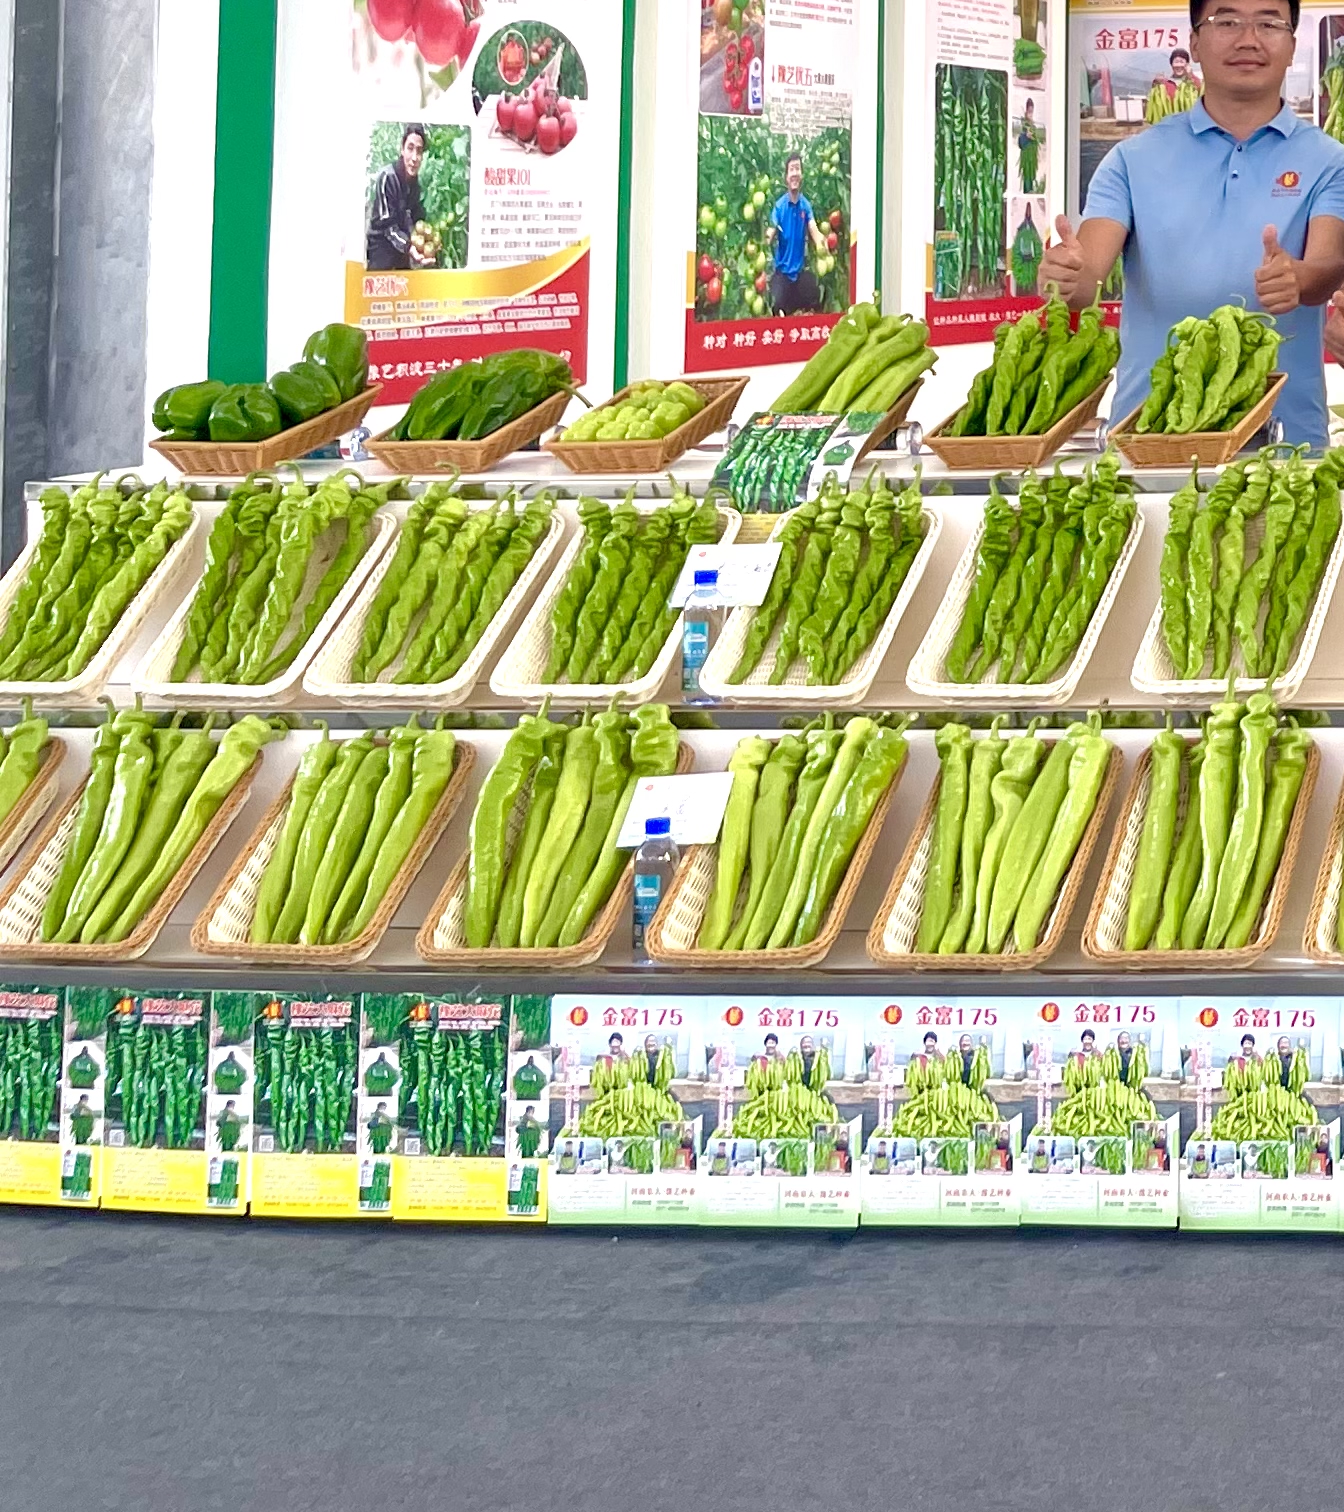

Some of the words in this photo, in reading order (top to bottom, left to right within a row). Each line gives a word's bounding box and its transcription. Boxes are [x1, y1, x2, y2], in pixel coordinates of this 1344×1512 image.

[1094, 28, 1179, 51] 金富175
[602, 1007, 683, 1028] 金富175
[757, 1007, 839, 1028] 金富175
[916, 1005, 998, 1027] 金富175
[1073, 1003, 1156, 1024] 金富175
[1232, 1008, 1316, 1028] 金富175
